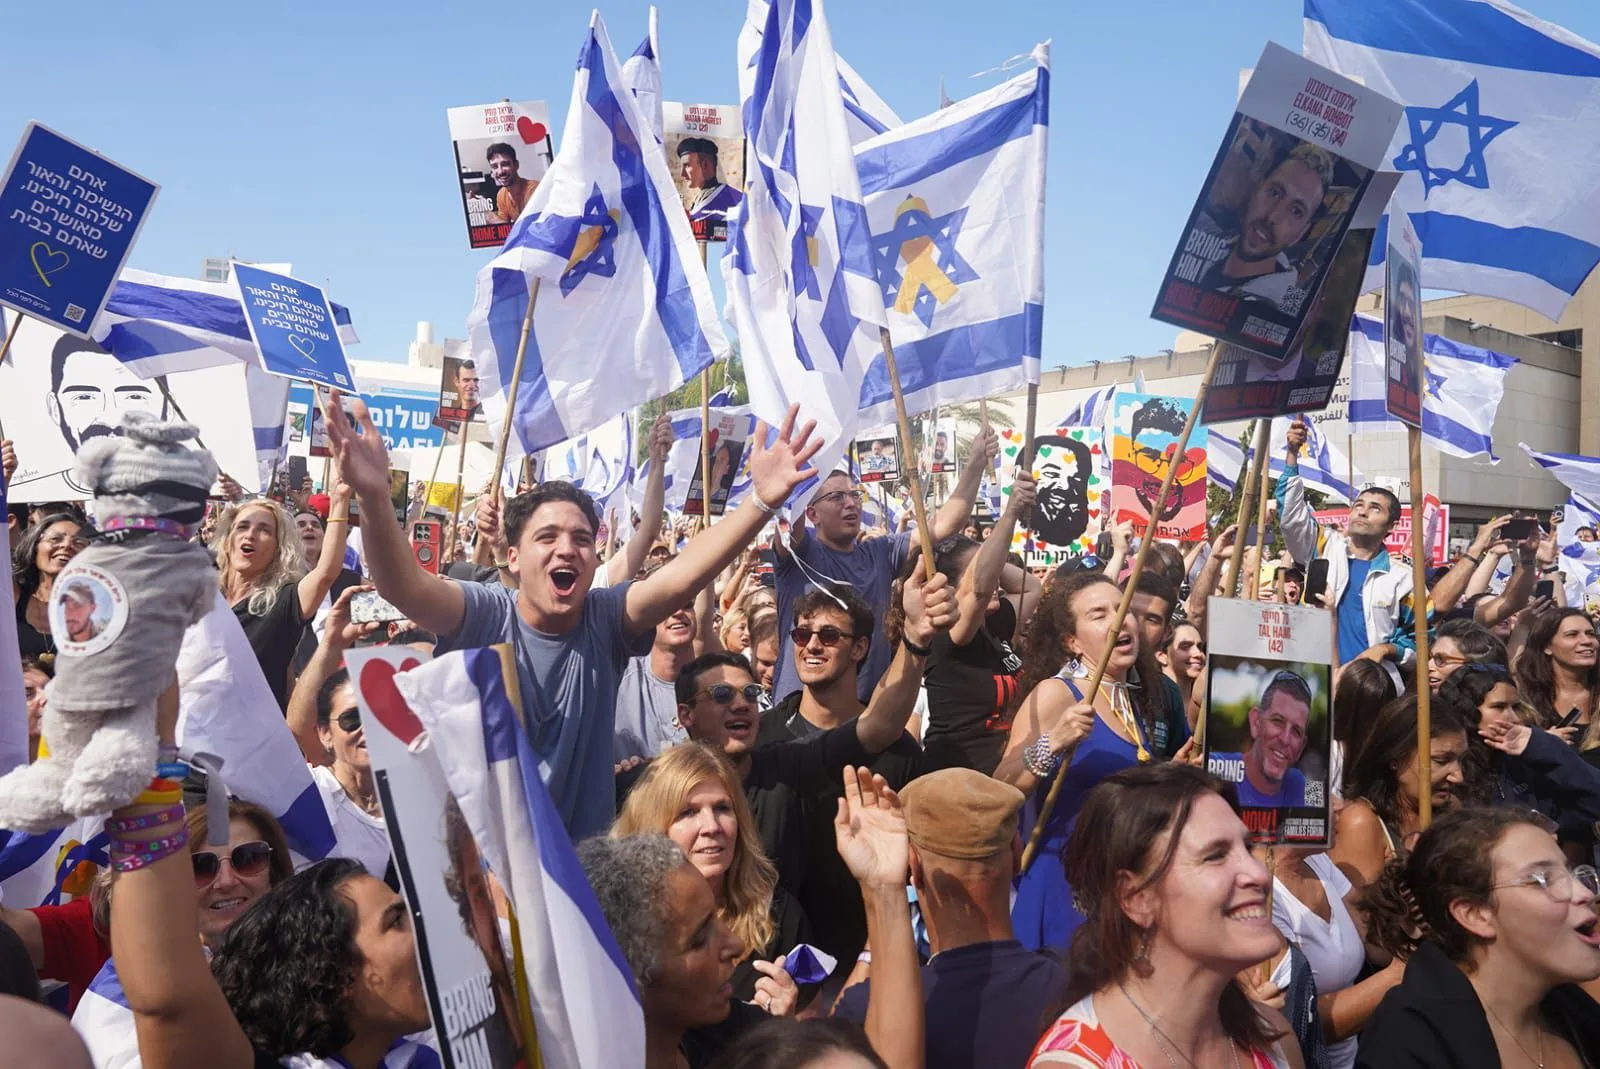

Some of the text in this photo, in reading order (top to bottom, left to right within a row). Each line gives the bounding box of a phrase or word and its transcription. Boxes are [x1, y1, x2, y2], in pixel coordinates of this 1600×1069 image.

[1292, 91, 1354, 130] ELKANA BOHBOT
[27, 160, 134, 222] הנשימה והאור
[68, 165, 108, 192] אתם
[74, 203, 124, 233] שלהם
[467, 197, 494, 213] BRING
[30, 199, 102, 241] מאושרים
[469, 212, 487, 227] HIM
[9, 208, 108, 260] שאתם בבית
[1173, 252, 1204, 283] HIM
[244, 286, 326, 314] הנשימה והאור
[271, 282, 299, 297] אתם
[267, 308, 319, 329] מאושרים
[291, 305, 325, 322] שלהם
[261, 316, 330, 341] שאתם בבית
[367, 404, 431, 430] שלום
[1258, 623, 1271, 638] TAL
[1268, 639, 1284, 655] (42)
[1207, 758, 1246, 783] BRING
[439, 971, 497, 1041] BRING
